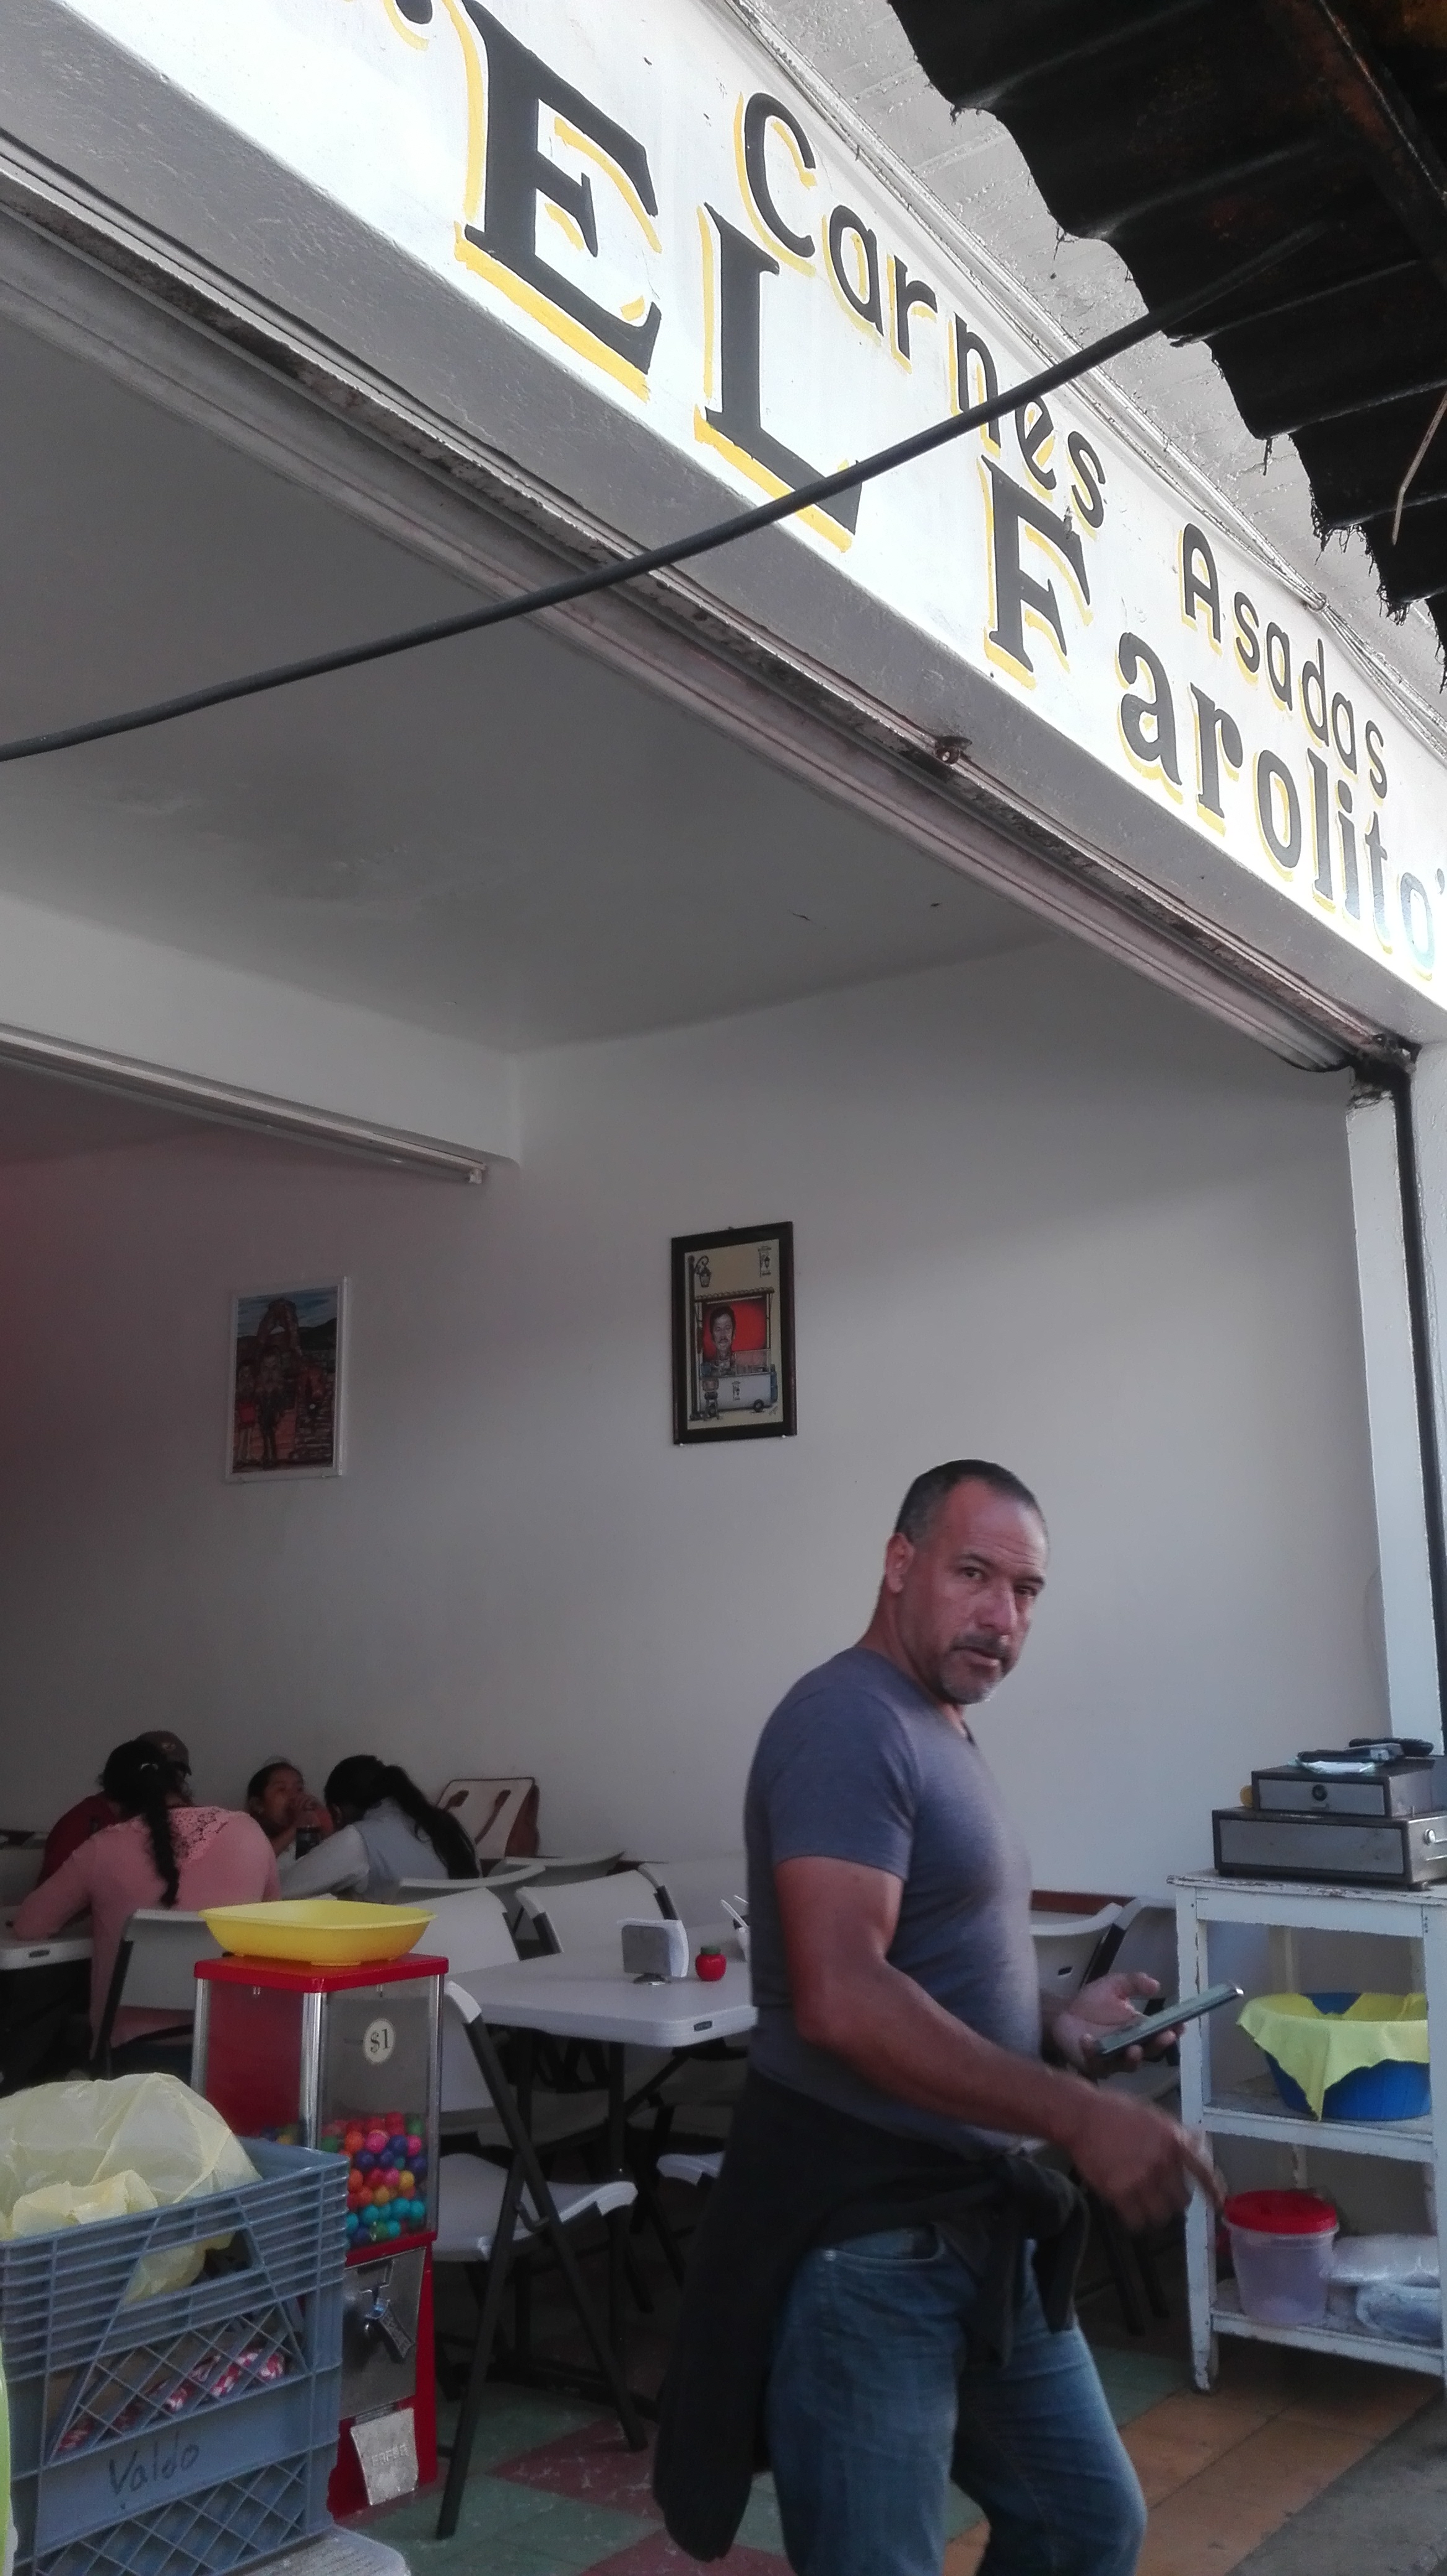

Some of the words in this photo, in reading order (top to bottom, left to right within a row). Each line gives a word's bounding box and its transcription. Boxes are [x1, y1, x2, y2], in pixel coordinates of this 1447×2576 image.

[744, 92, 1106, 529] Carnes
[1182, 522, 1388, 799] Asadas
[370, 2028, 390, 2054] $1
[108, 2429, 199, 2495] Valdo
